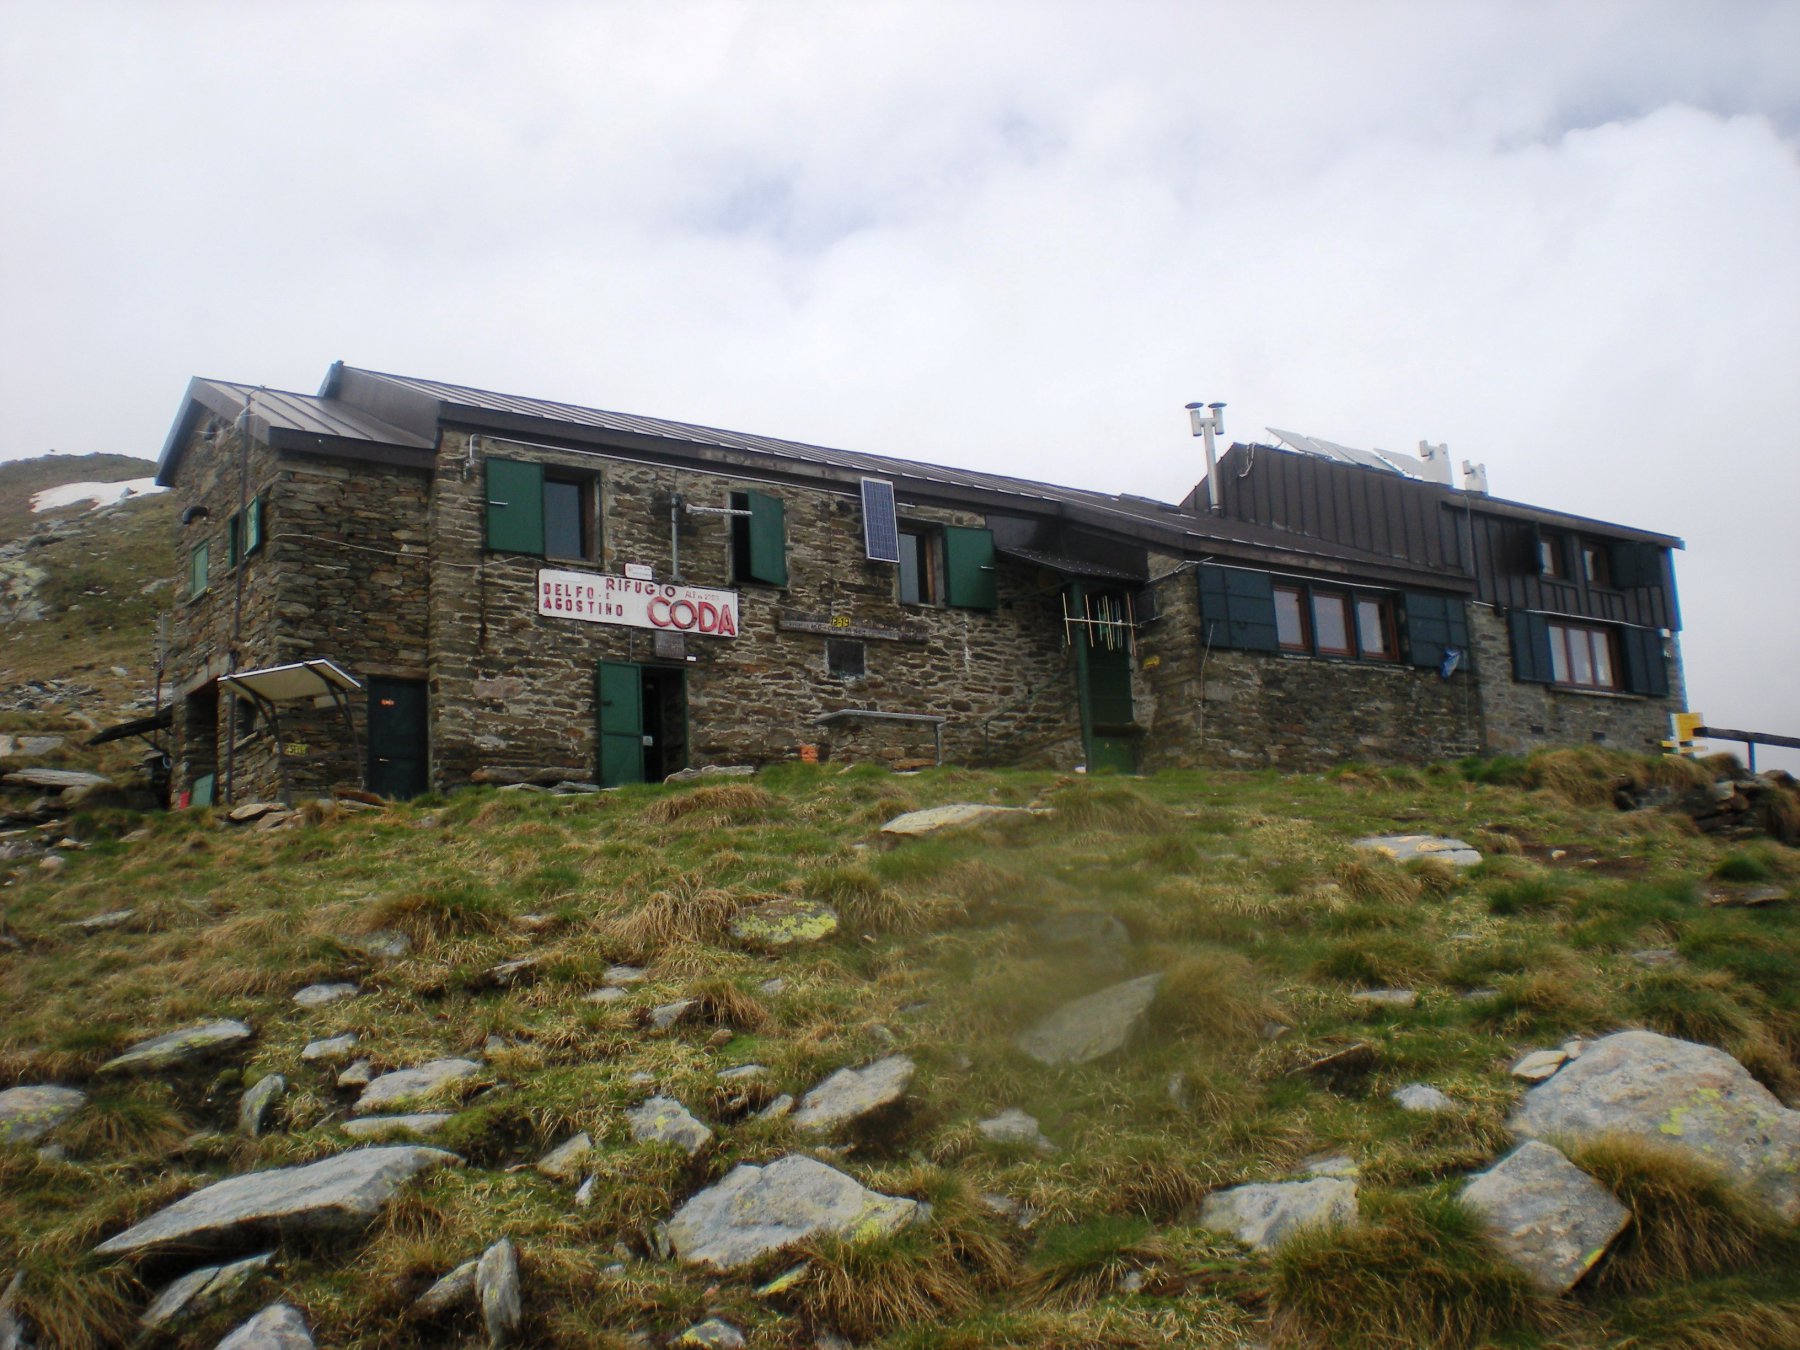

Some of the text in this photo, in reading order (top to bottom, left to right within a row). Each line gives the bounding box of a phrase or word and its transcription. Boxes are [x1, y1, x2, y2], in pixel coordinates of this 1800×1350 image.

[606, 578, 675, 597] RIFUGO
[543, 596, 623, 616] AGOSTINO
[647, 595, 736, 636] CODA
